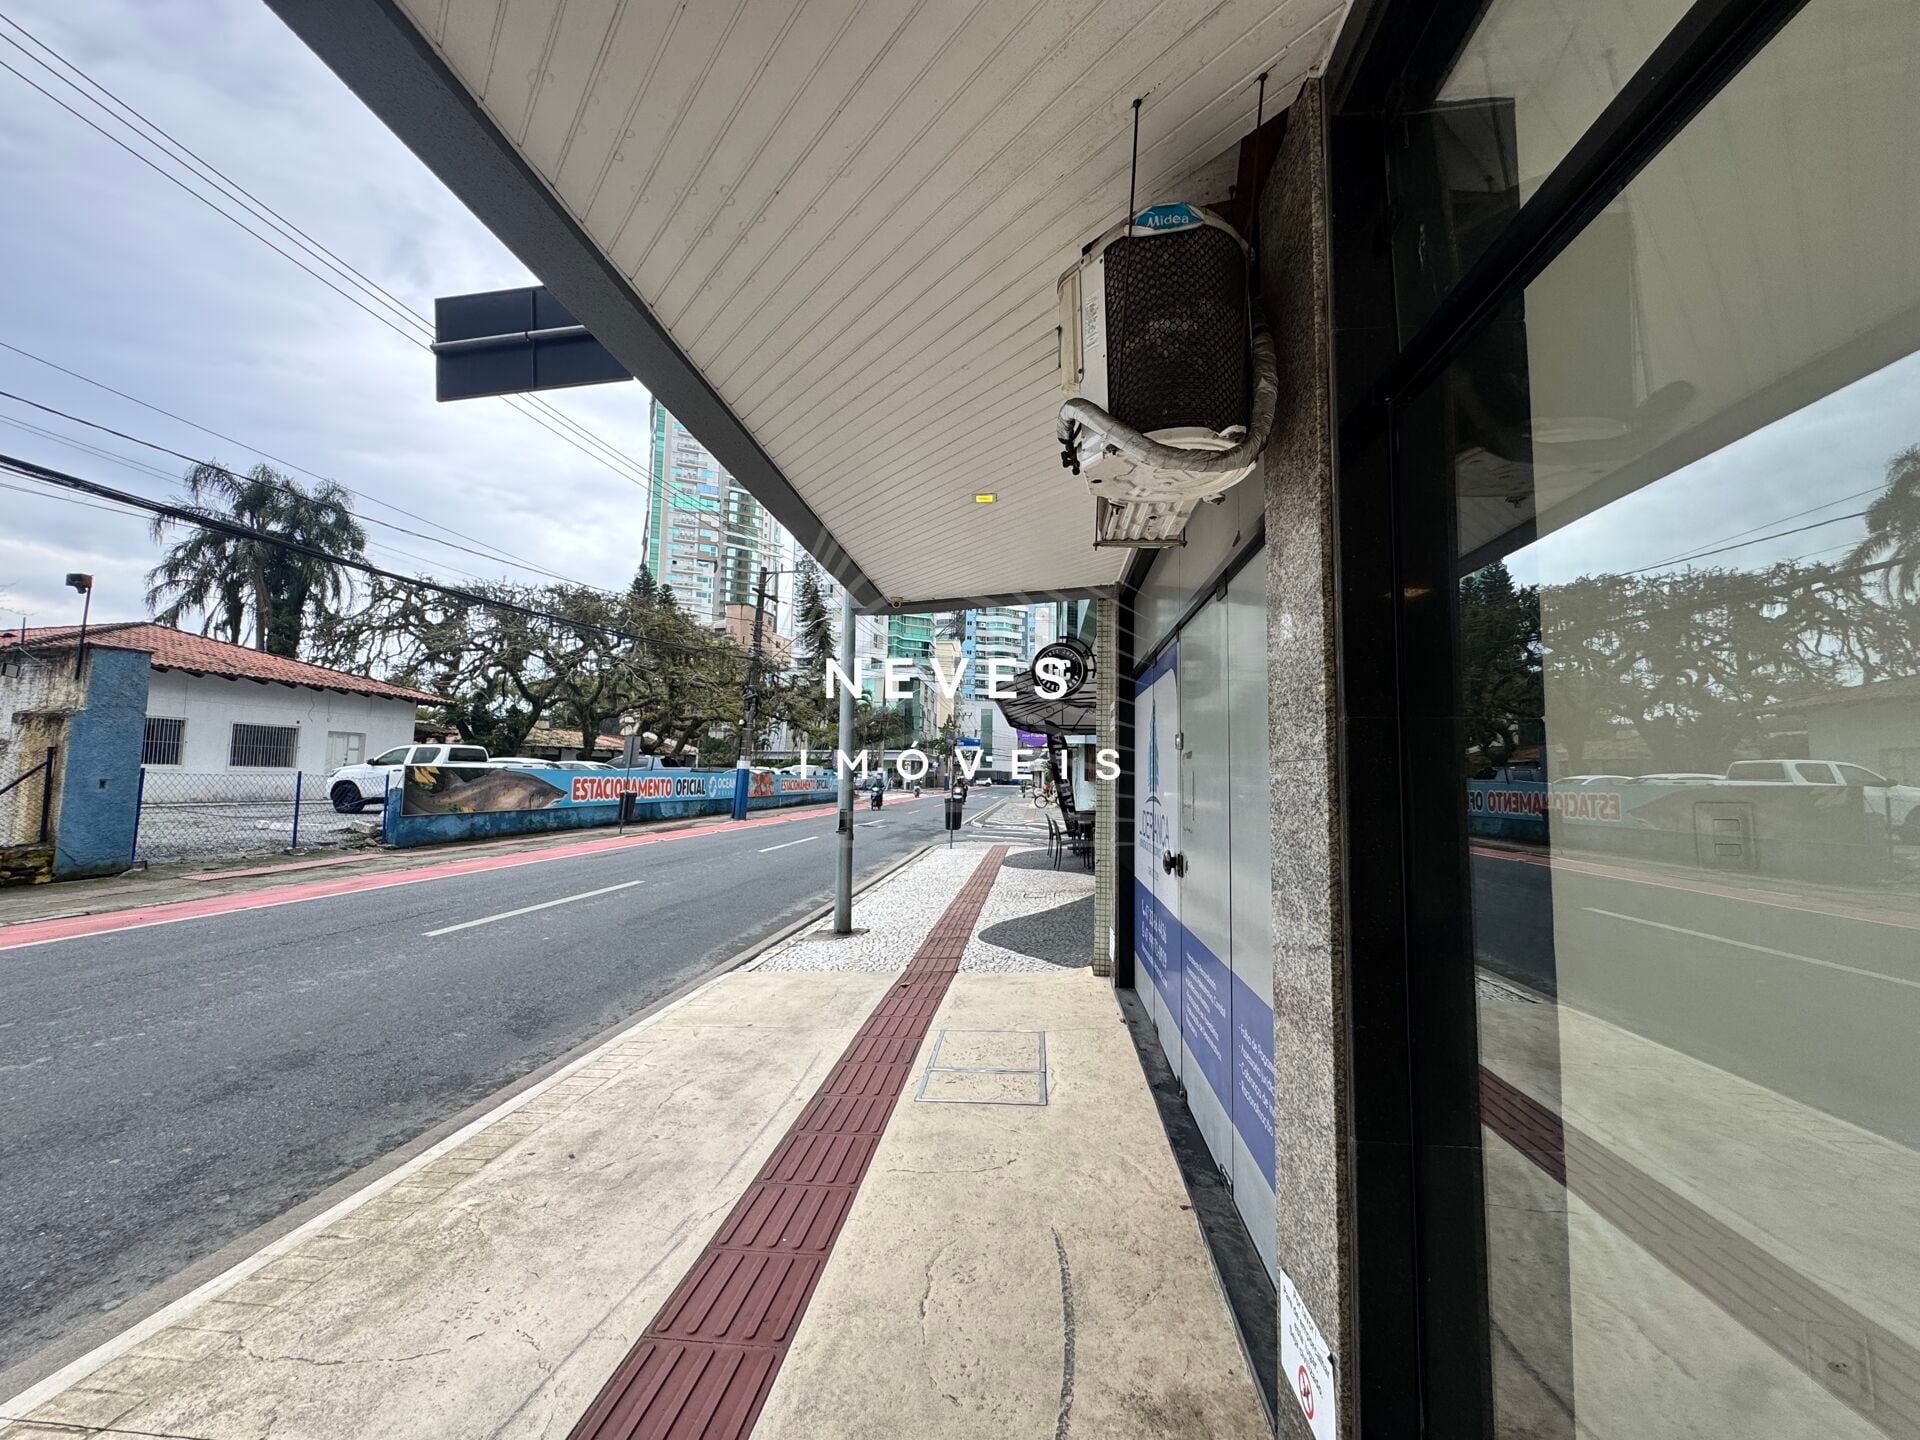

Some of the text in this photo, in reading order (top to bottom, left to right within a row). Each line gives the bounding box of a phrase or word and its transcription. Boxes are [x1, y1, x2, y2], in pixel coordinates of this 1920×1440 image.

[1146, 214, 1189, 228] Midea
[572, 777, 736, 801] ESTACIONAMENTO OFICIAL OCEAN
